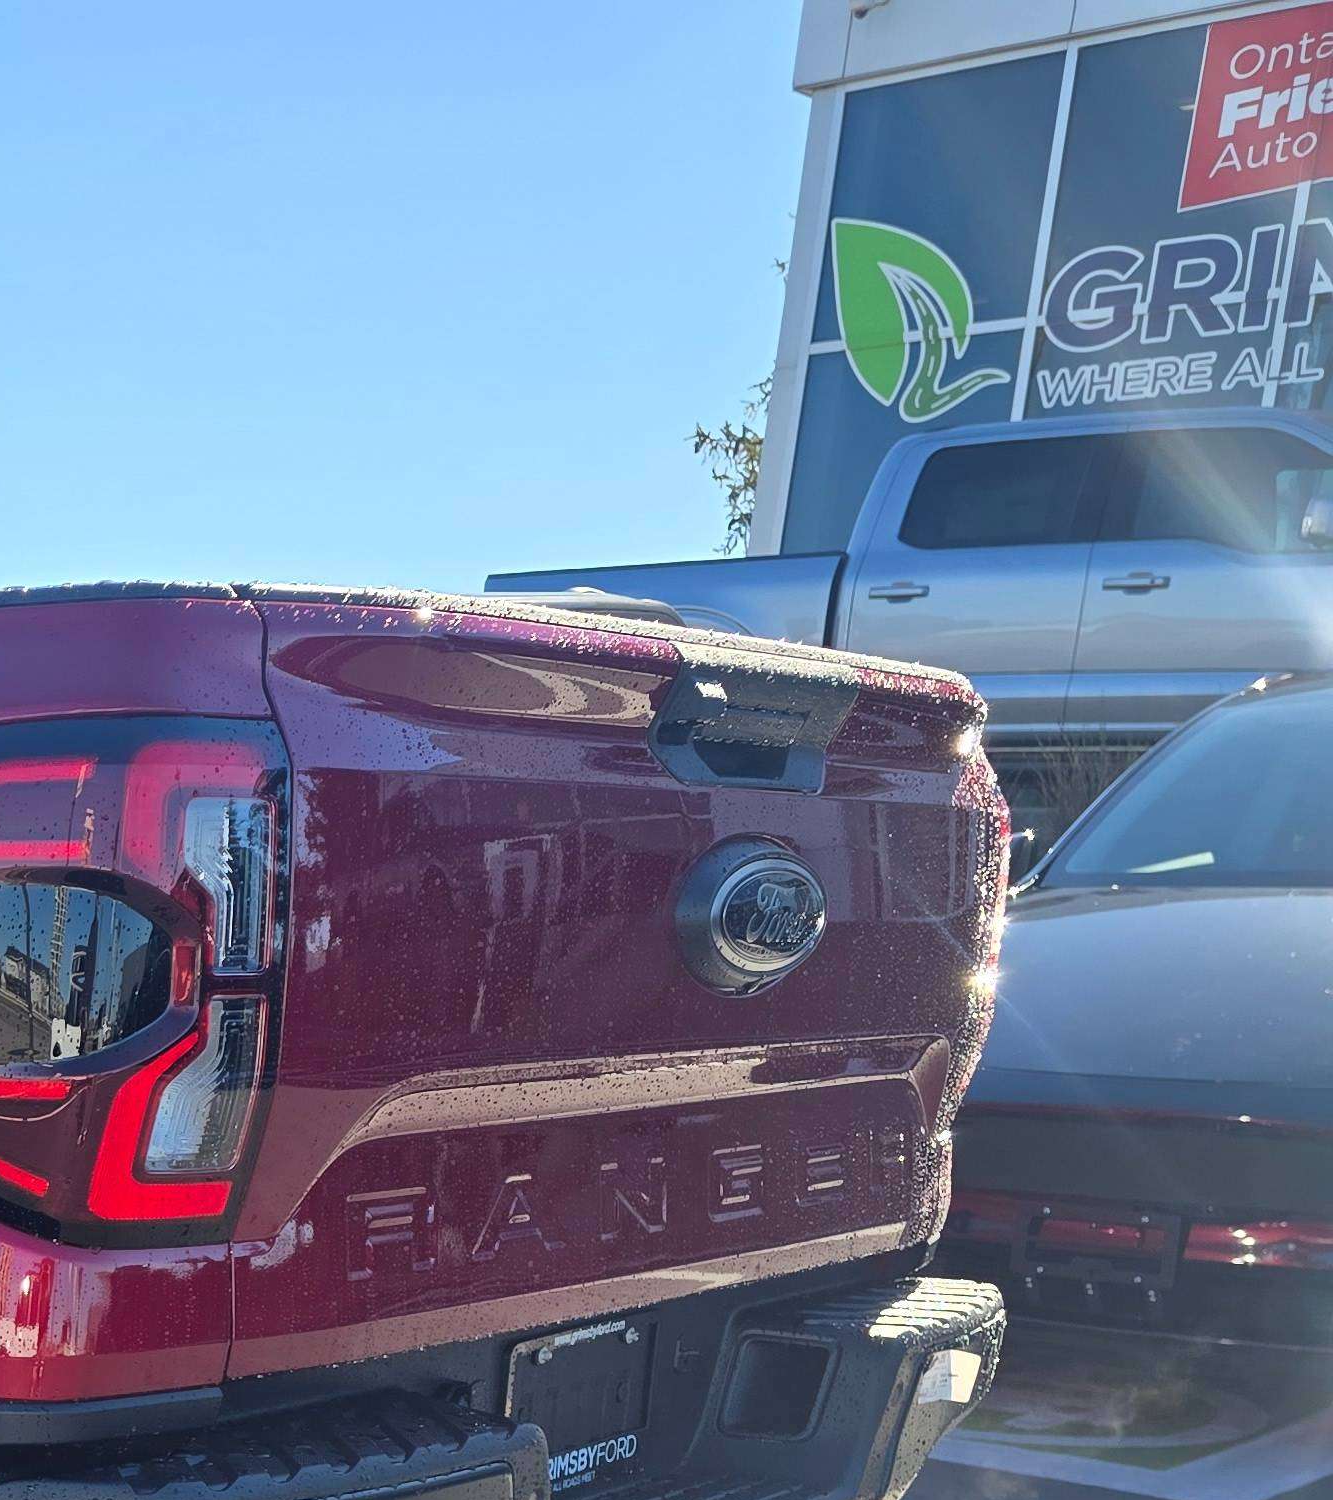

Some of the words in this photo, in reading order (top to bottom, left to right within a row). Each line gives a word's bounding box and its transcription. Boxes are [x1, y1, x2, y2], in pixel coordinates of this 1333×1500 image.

[1230, 32, 1333, 80] Onta
[1217, 73, 1333, 138] Frie
[1209, 131, 1318, 179] Auto
[1036, 351, 1217, 409] WHERE
[1221, 342, 1325, 391] ALL
[745, 882, 810, 943] Ford
